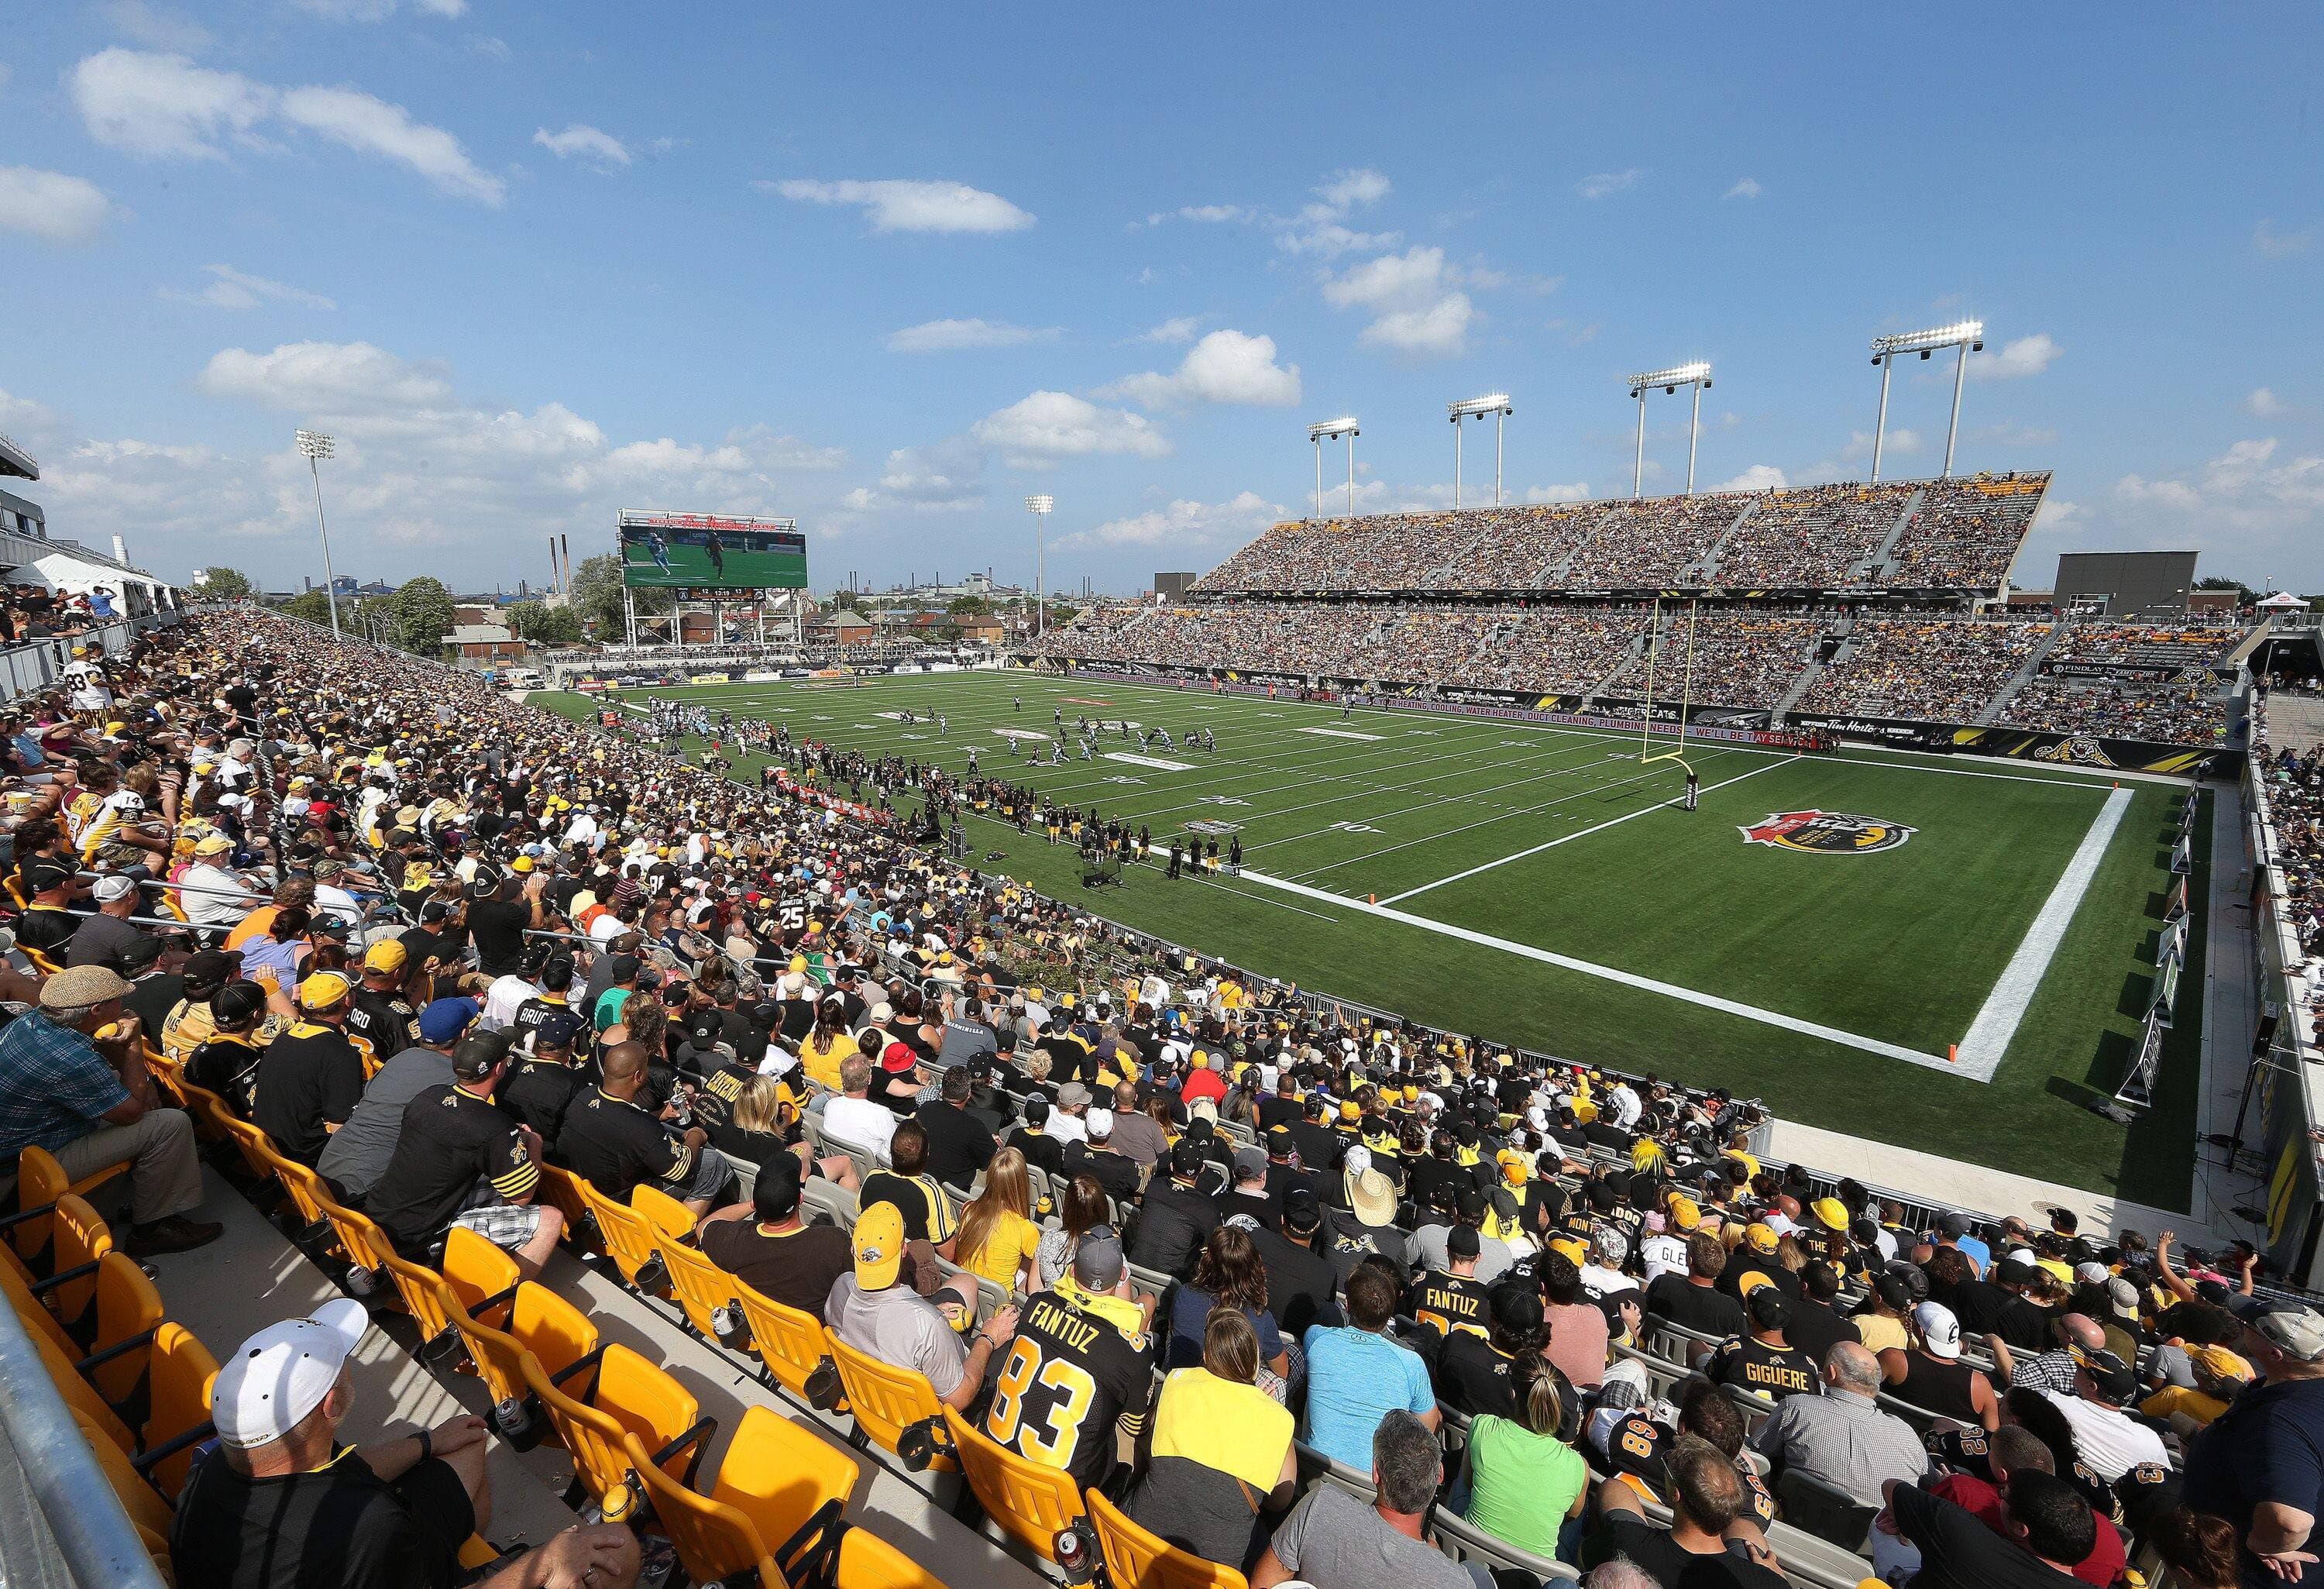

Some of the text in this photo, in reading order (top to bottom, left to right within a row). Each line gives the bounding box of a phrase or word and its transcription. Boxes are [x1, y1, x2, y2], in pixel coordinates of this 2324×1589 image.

[67, 674, 87, 692] 83
[1243, 685, 1261, 693] NEEDS
[1463, 690, 1499, 702] Tim Hortons
[1397, 701, 1429, 710] HEATING,
[1431, 703, 1464, 714] COOLING,
[1466, 707, 1490, 715] WATER
[1492, 709, 1525, 721] HEATER,
[1528, 712, 1549, 721] DUCT
[1551, 714, 1597, 727] CLEANING,
[1599, 719, 1647, 731] PLUMBING
[1649, 724, 1682, 734] NEEDS
[1730, 731, 1744, 741] BE
[1827, 719, 1845, 731] Tim
[125, 795, 139, 806] 14
[576, 786, 592, 801] 32
[779, 906, 805, 930] 25
[1808, 1240, 1828, 1254] THE
[1426, 1288, 1480, 1317] FANTUZ
[1028, 1300, 1100, 1354] FANTUZ
[1745, 1362, 1810, 1391] GIGUERE
[985, 1334, 1097, 1470] 83
